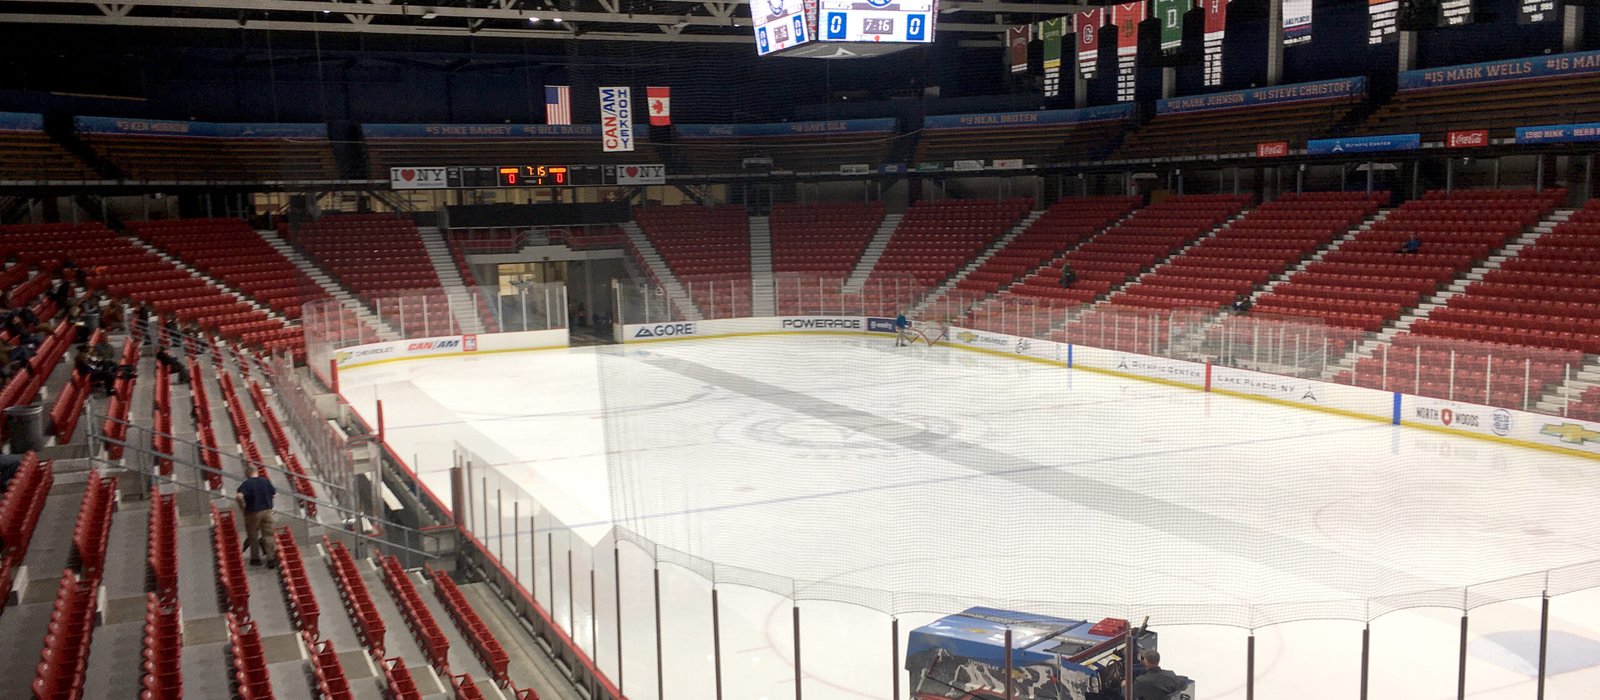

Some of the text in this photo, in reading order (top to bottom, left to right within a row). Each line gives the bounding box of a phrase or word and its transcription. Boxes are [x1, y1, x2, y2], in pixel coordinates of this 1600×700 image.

[829, 16, 840, 33] 0
[865, 20, 889, 31] 7:16
[909, 18, 920, 35] 0
[1546, 58, 1569, 71] #16
[1423, 62, 1532, 82] #15 MARK WELLS
[1268, 87, 1297, 100] STEVE
[1299, 81, 1352, 97] CHRISTOFF
[1182, 98, 1205, 108] MARK
[1207, 93, 1244, 106] JOHNSON
[618, 89, 630, 149] HOCKEY
[974, 115, 1000, 125] NEAL
[1001, 113, 1038, 124] BROTEN
[442, 127, 468, 135] MIKE
[470, 126, 513, 135] RAMSEY
[561, 127, 593, 135] BAKER
[416, 168, 444, 182] NY
[556, 173, 563, 183] 0
[638, 166, 662, 178] NY
[508, 174, 515, 184] 0
[654, 323, 693, 337] GORE
[782, 319, 860, 329] POWERADE
[1281, 385, 1295, 393] NY
[1416, 407, 1480, 428] NORTH WOODS
